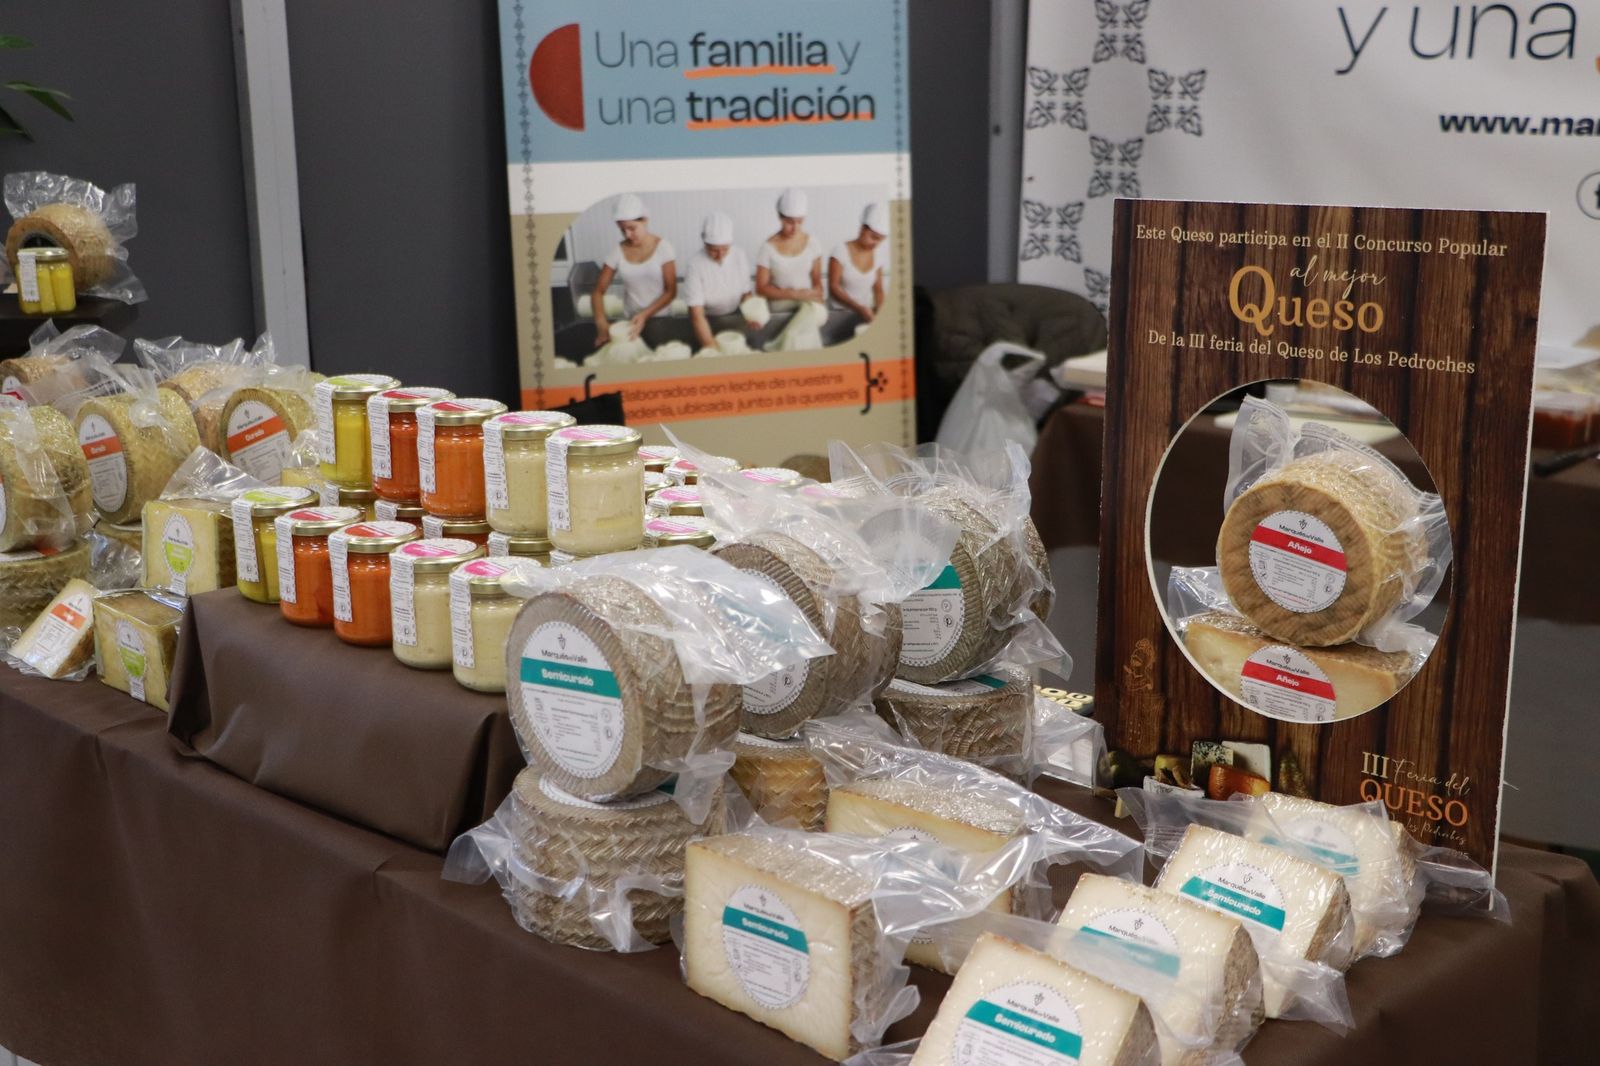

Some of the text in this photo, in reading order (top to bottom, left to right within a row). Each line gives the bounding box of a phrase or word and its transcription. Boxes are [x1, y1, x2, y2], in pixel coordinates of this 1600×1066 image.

[595, 31, 861, 74] Una familia y
[1335, 2, 1577, 75] y una
[599, 86, 875, 125] una tradición
[1136, 225, 1507, 259] Este Queso participa en el II Concurso Popular
[1290, 255, 1386, 299] al mejor
[1229, 265, 1384, 336] Queso
[1148, 330, 1475, 374] De la III feria del Queso de Los Pedroches
[624, 385, 697, 402] laborados
[729, 379, 767, 393] leche
[1288, 540, 1312, 554] Añejo
[1276, 674, 1300, 687] Añejo
[1361, 751, 1470, 796] III Feria del
[1360, 778, 1469, 827] QUESO
[1208, 888, 1262, 917] Semicurado
[994, 1013, 1057, 1043] Semicurado
